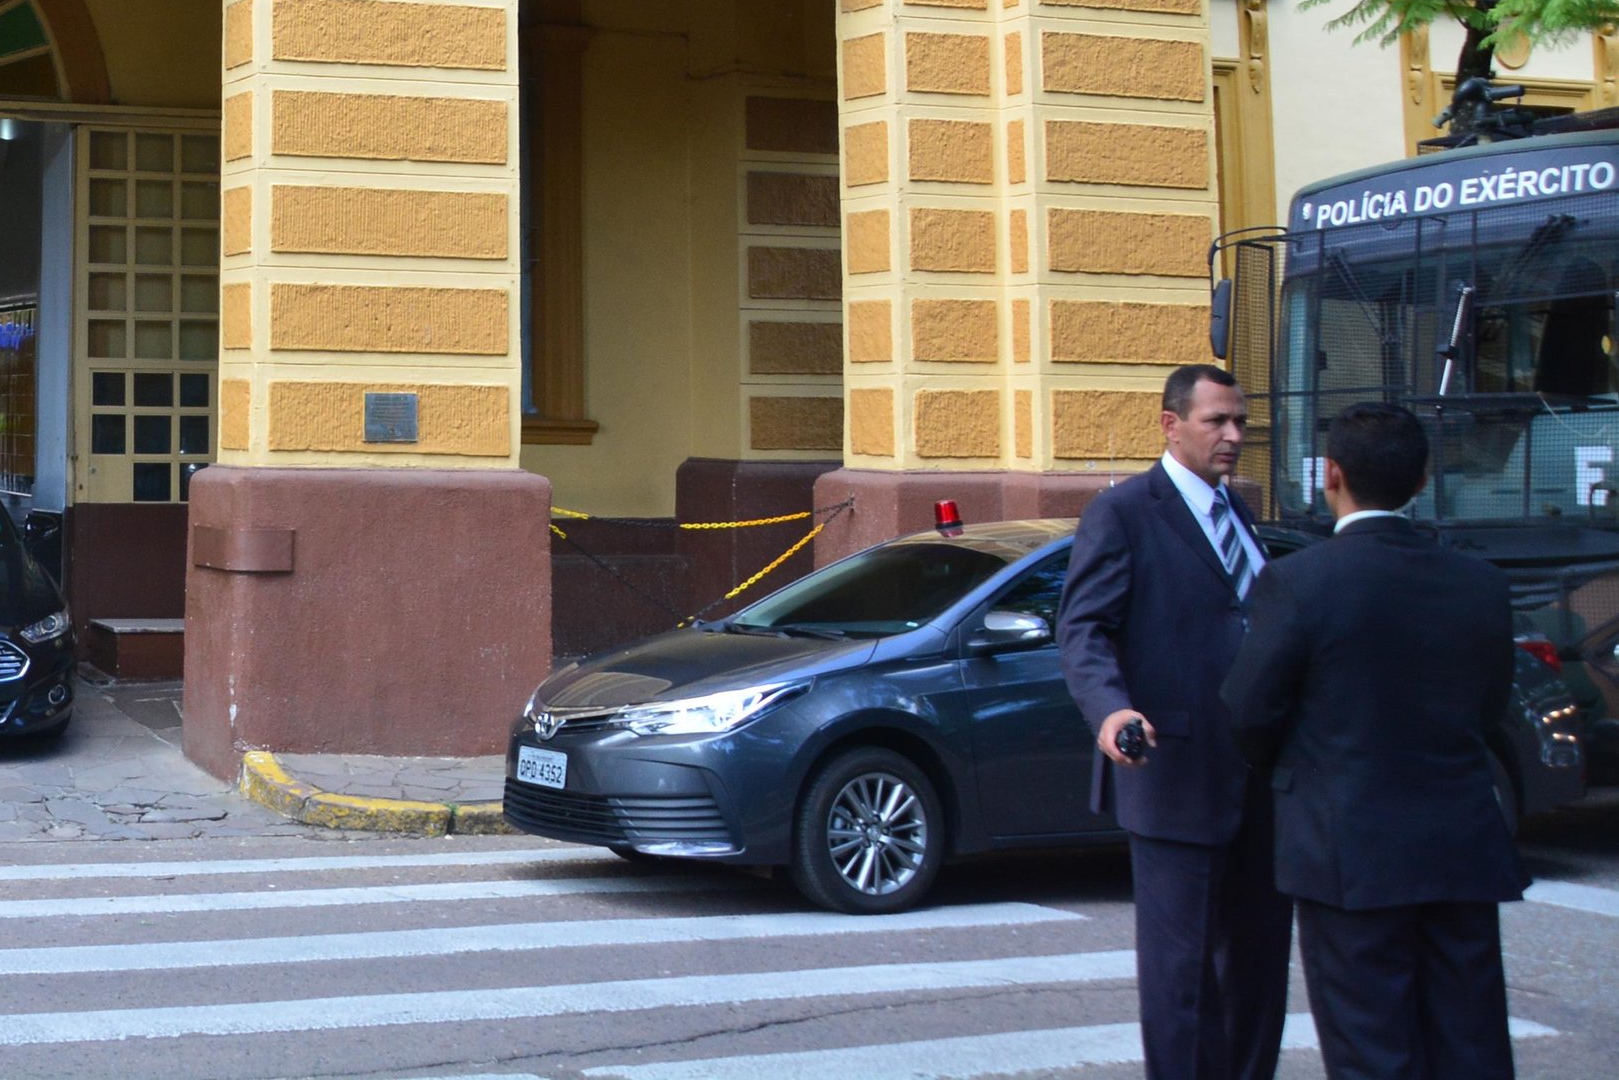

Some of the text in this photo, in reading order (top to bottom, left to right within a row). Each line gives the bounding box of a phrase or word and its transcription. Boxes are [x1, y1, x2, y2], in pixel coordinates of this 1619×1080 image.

[1315, 161, 1615, 229] POLÍCIA DO EXÉRCITO
